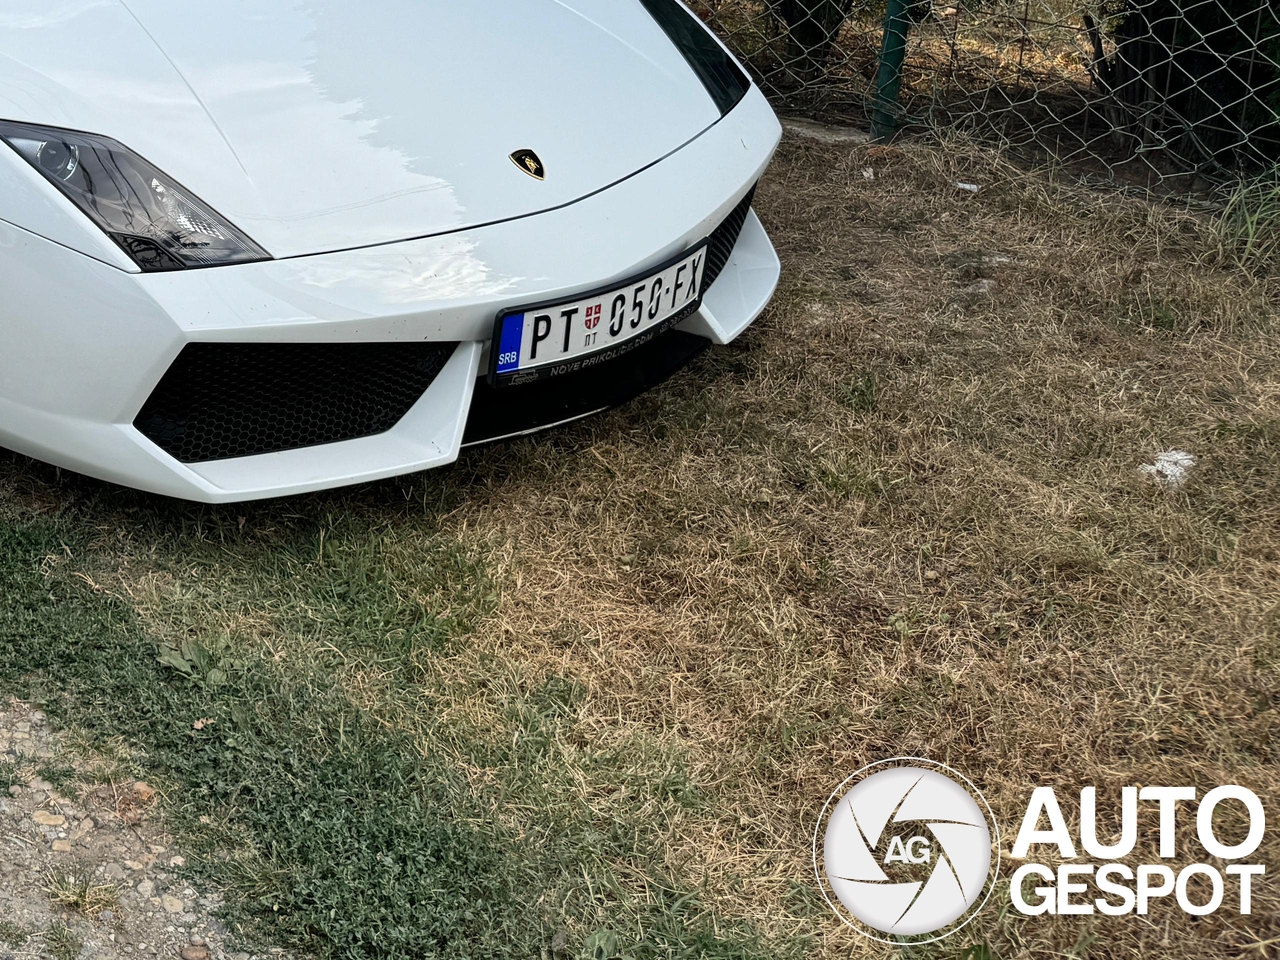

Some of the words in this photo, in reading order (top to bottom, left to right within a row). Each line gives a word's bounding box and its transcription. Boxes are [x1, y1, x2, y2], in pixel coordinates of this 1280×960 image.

[529, 307, 579, 359] PT
[498, 351, 517, 365] SRB
[550, 361, 581, 377] NOVE
